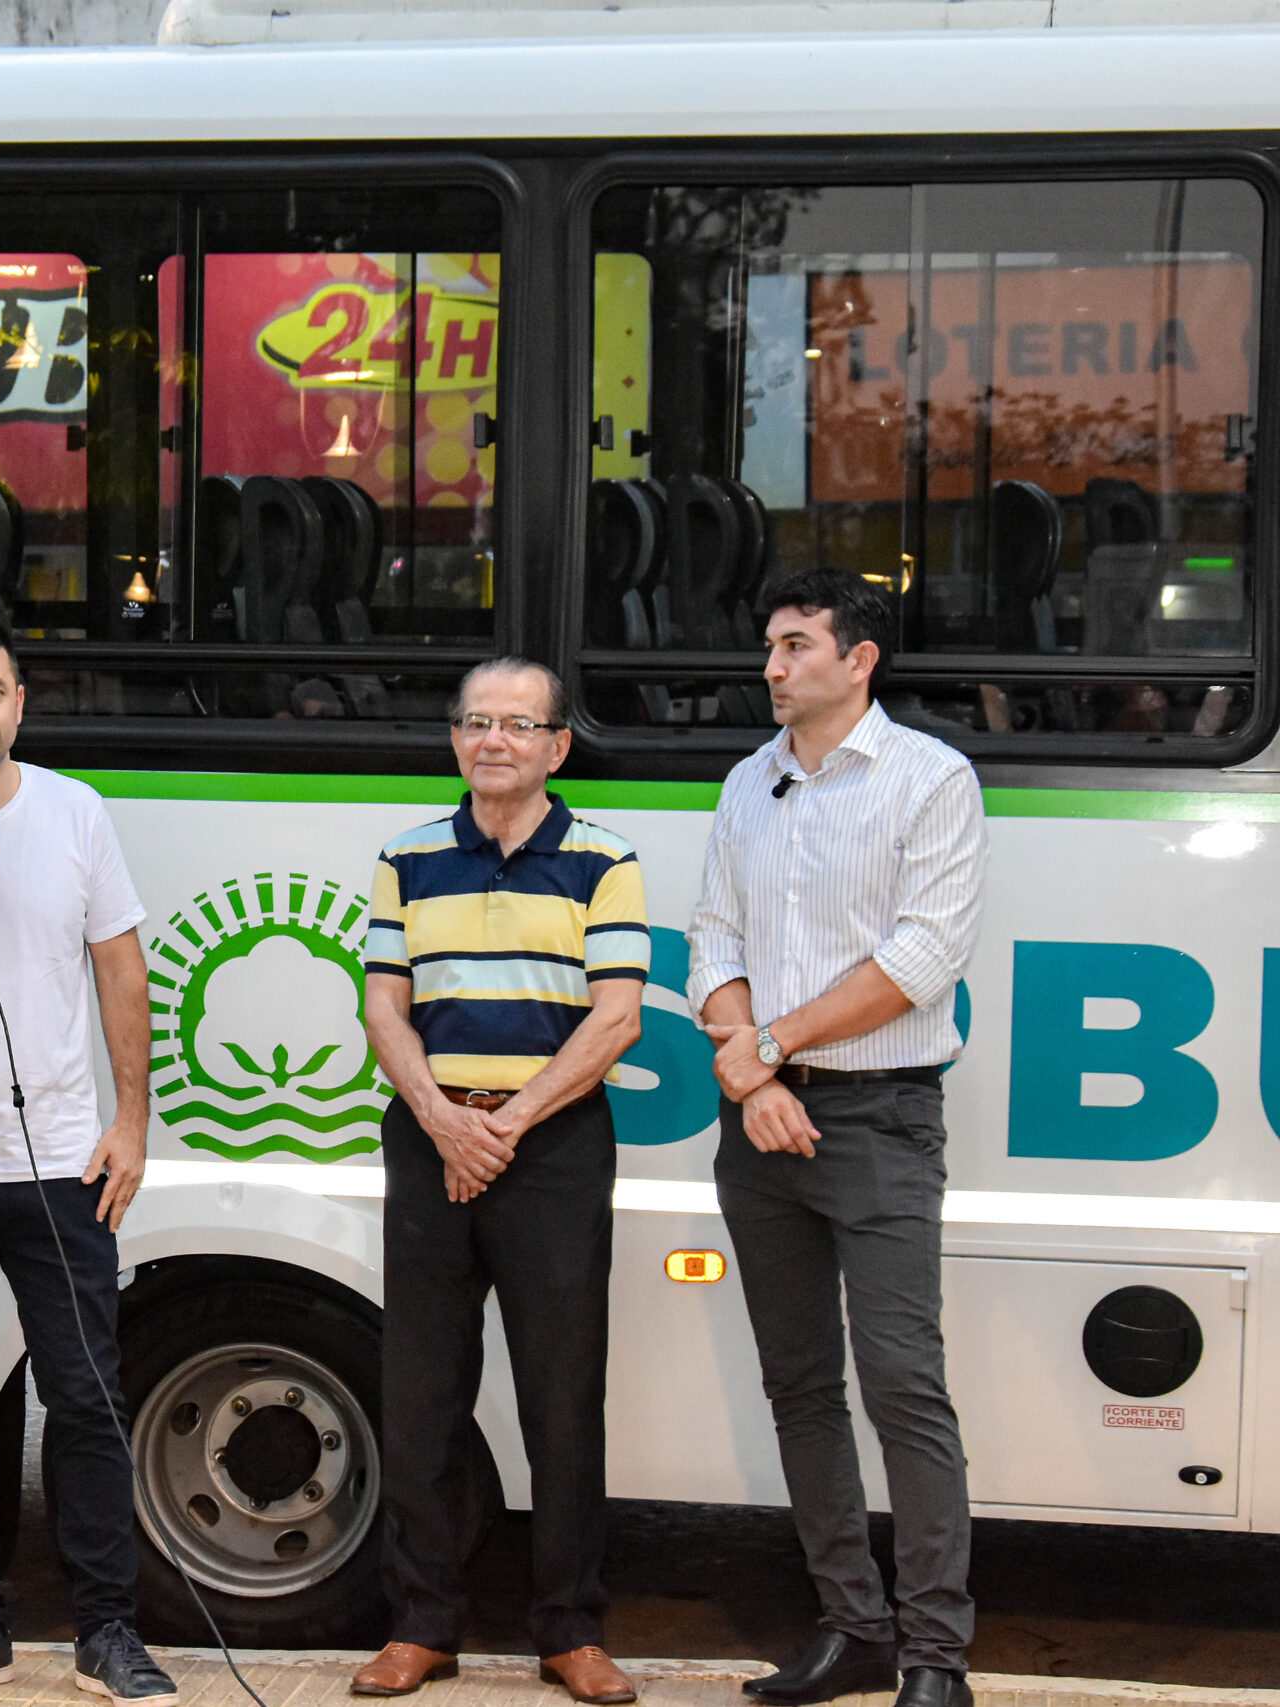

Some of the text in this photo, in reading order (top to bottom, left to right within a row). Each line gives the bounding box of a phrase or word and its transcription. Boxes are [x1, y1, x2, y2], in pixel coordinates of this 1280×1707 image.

[849, 318, 1198, 382] LOTERIA
[1112, 1407, 1175, 1418] CORTE DE
[1107, 1416, 1180, 1428] CORRIENTE
